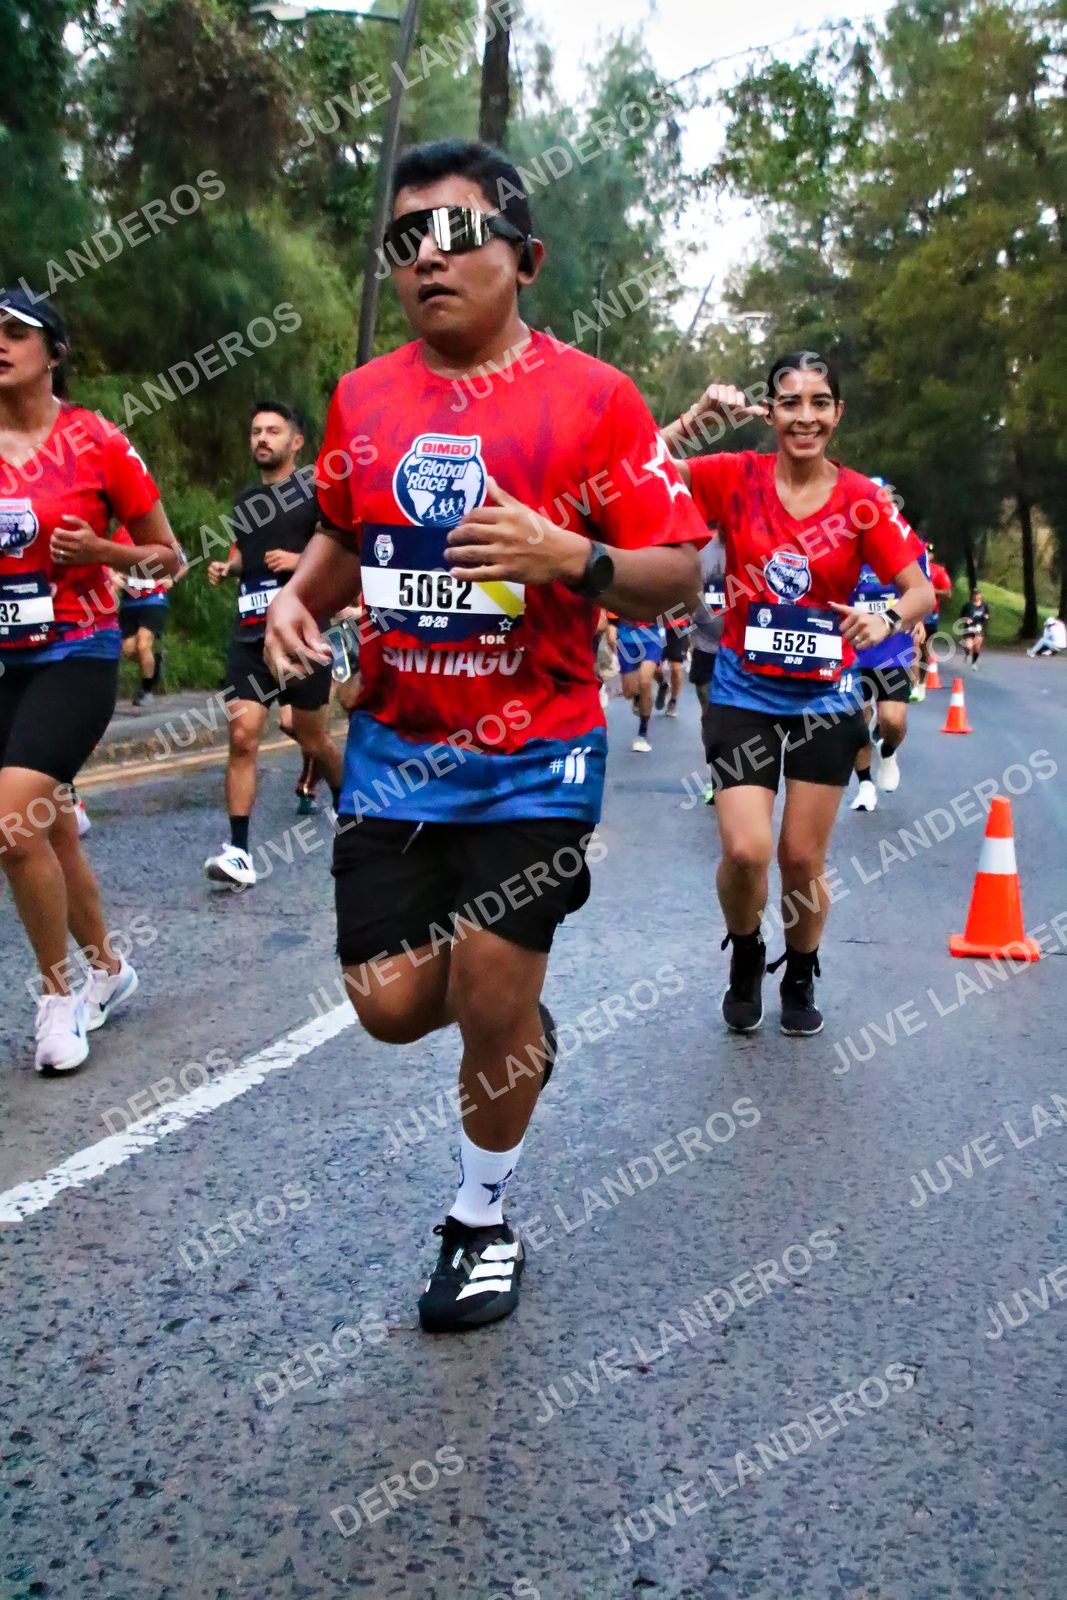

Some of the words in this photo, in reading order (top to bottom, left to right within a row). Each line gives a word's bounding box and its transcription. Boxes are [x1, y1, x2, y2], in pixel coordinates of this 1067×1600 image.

[422, 443, 472, 455] BIMBO
[419, 459, 468, 478] Global
[407, 472, 447, 491] Race
[399, 573, 472, 610] 5062
[418, 615, 448, 628] 20-26
[479, 635, 506, 644] 10K
[773, 631, 817, 654] 5525
[382, 645, 523, 677] SANTIAGO
